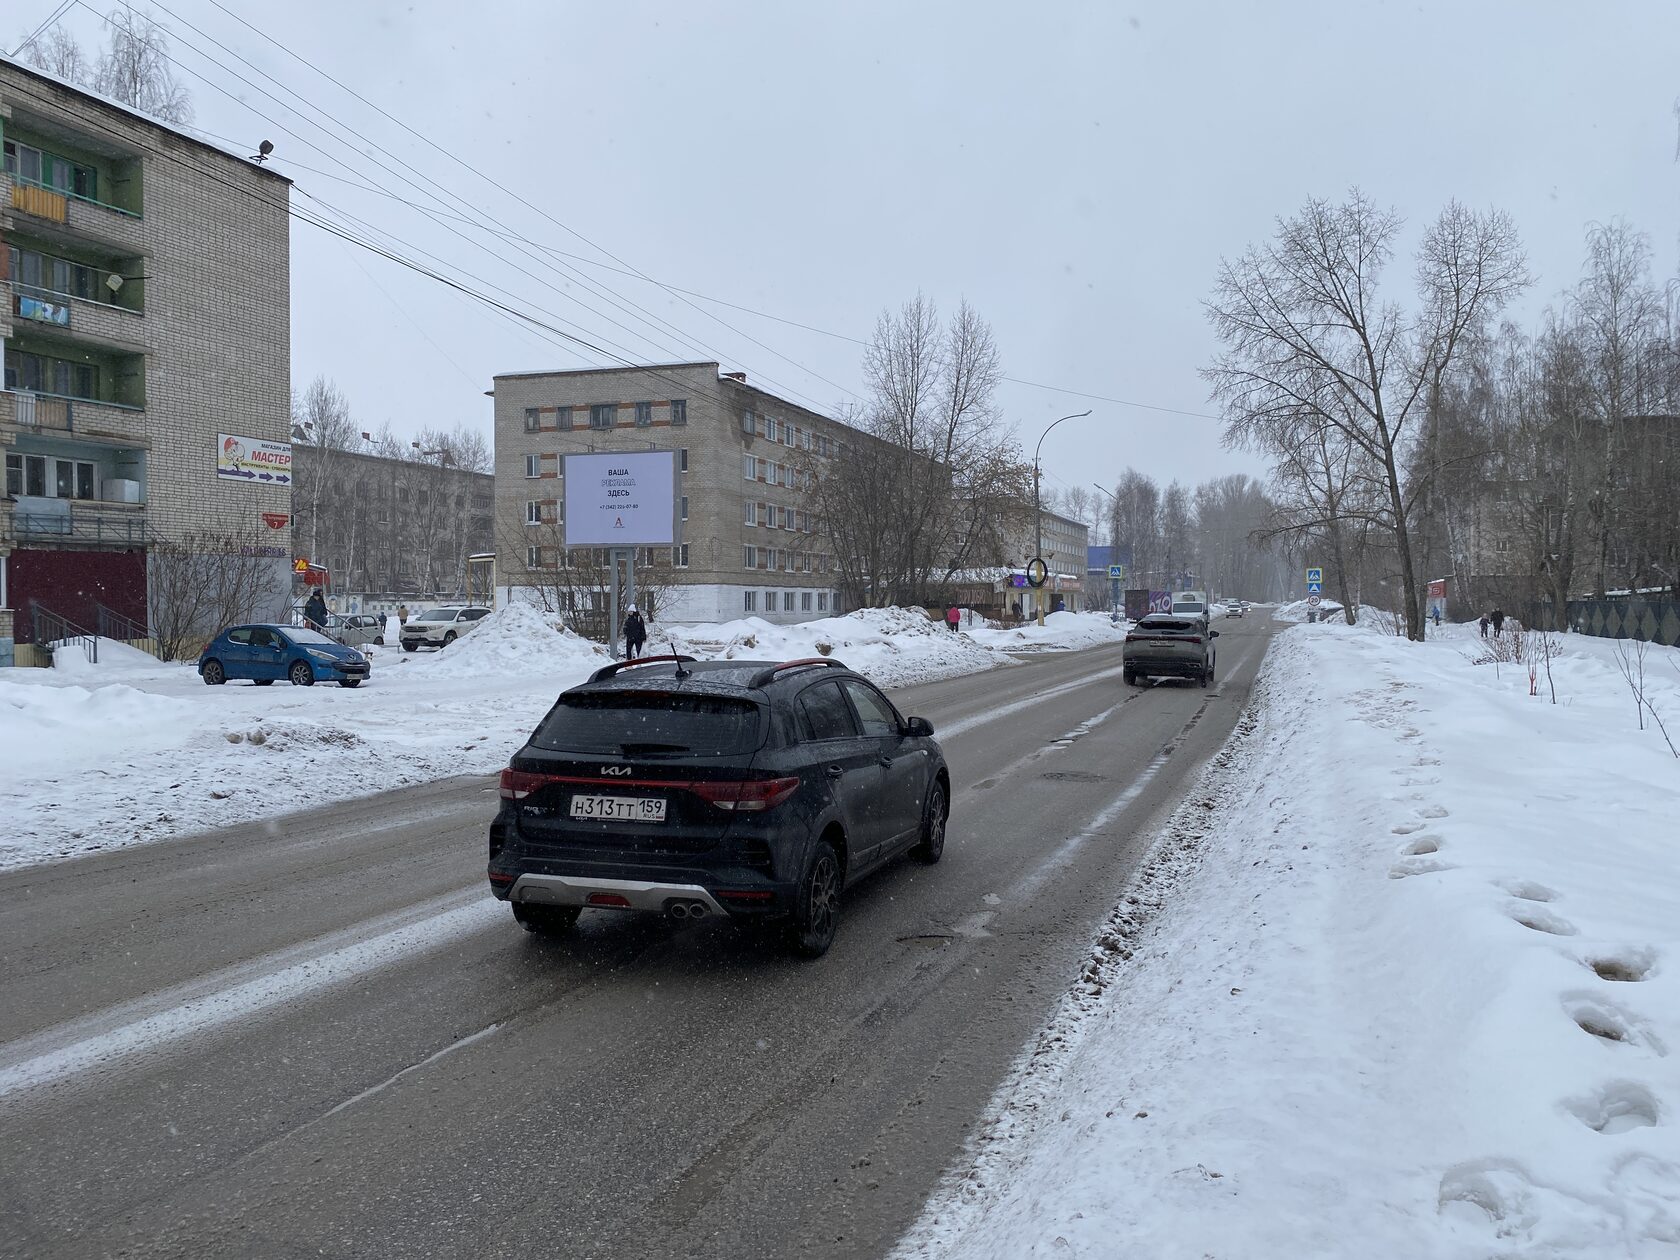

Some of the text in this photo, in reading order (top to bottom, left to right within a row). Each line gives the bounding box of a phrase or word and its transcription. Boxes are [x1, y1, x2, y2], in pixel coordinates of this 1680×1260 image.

[261, 443, 282, 451] МАГАЗИН
[251, 450, 291, 465] МАСТЕР
[601, 479, 636, 487] РЕКЛАМА
[607, 489, 630, 498] ЗДЕСЬ
[601, 766, 632, 776] KIA
[639, 799, 662, 813] 159
